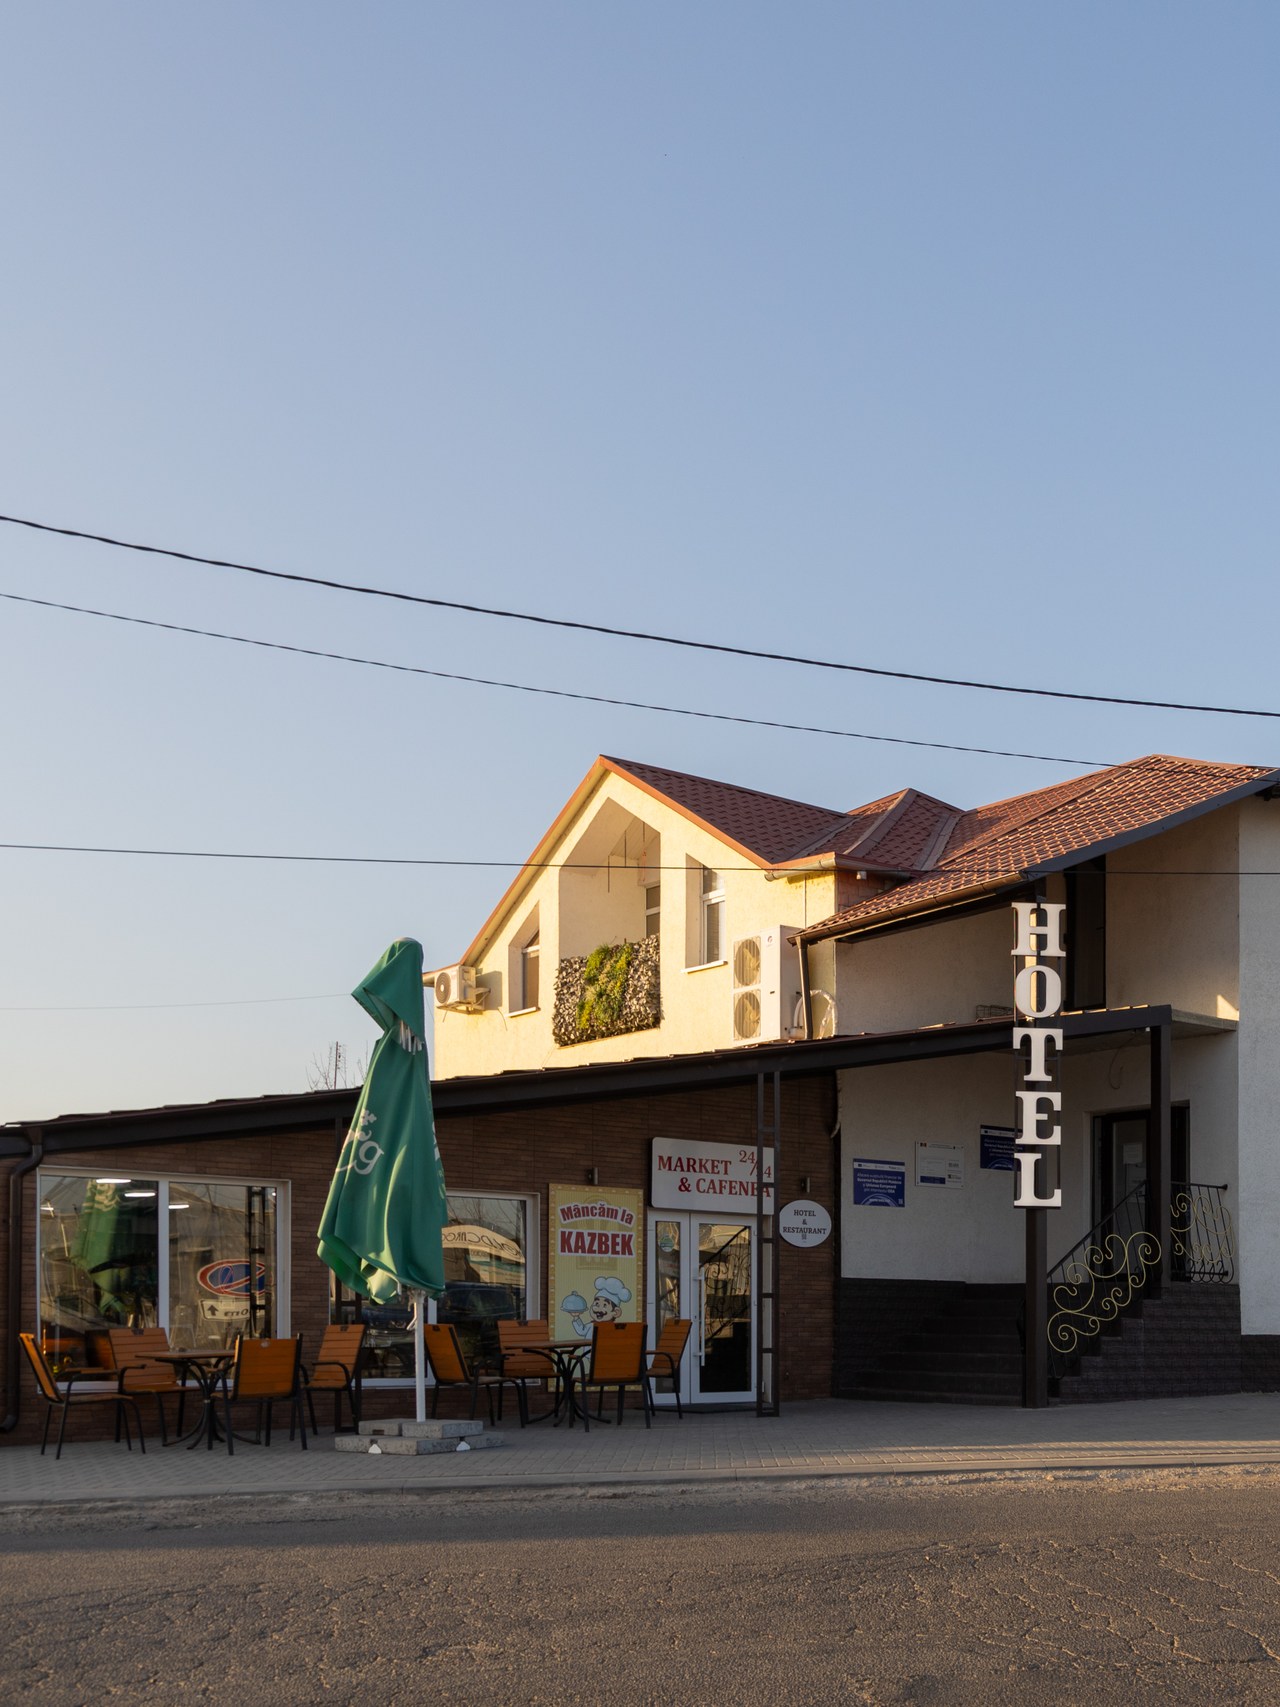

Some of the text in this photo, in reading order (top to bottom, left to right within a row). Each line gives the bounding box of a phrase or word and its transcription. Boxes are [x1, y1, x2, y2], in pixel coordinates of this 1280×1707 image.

[1011, 902, 1067, 1208] HOTEL
[657, 1149, 772, 1179] MARKET 24/4
[678, 1176, 692, 1193] &
[560, 1203, 634, 1225] Mâncăm la
[793, 1209, 816, 1217] HOTEL
[802, 1218, 808, 1226] &
[782, 1226, 827, 1235] RESTAURANT
[560, 1230, 634, 1256] KAZBEK
